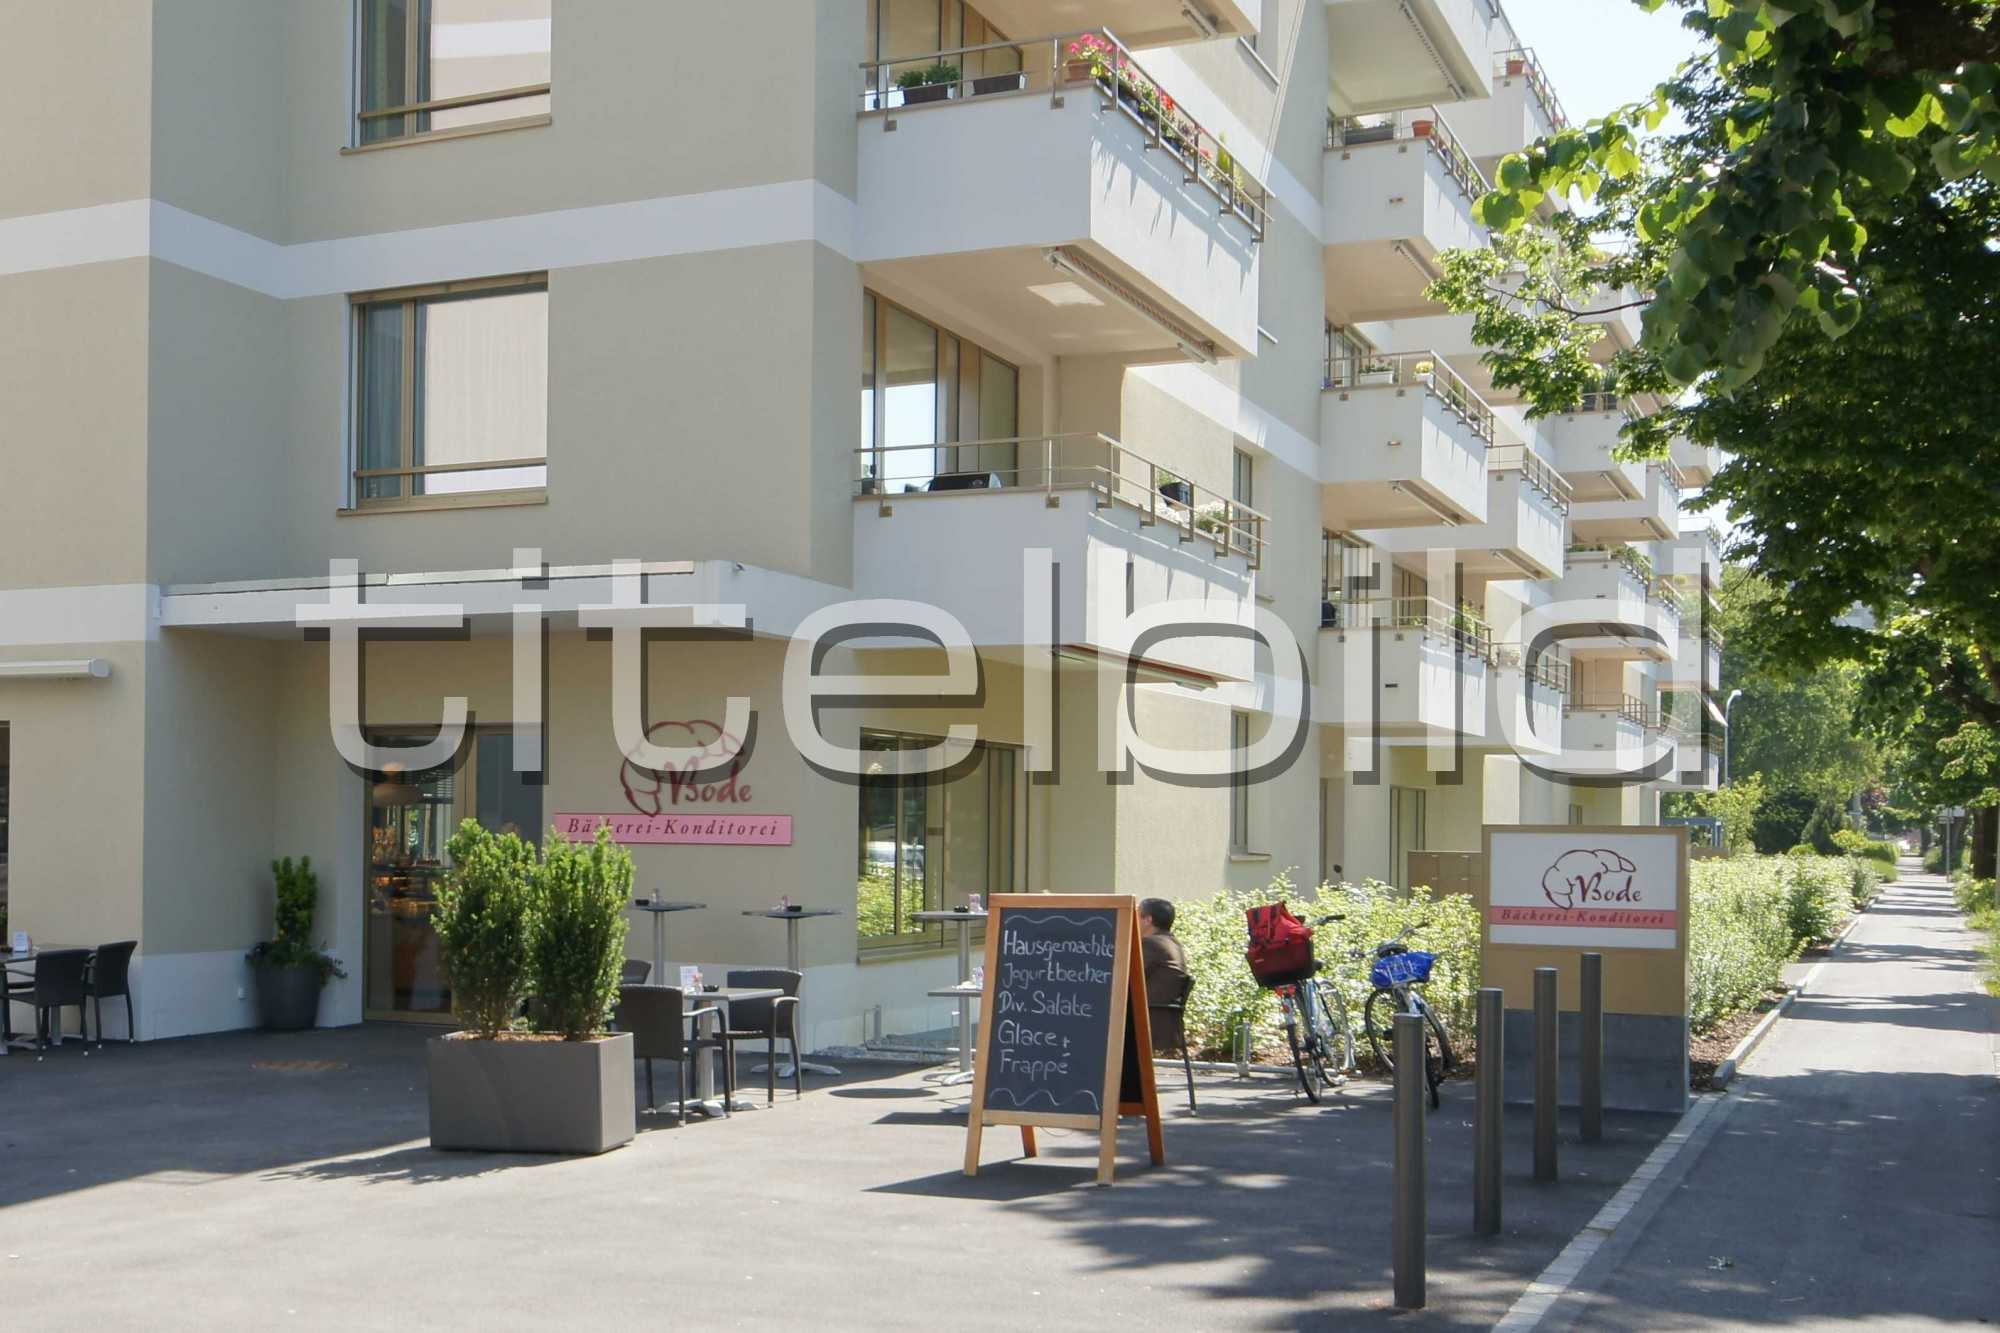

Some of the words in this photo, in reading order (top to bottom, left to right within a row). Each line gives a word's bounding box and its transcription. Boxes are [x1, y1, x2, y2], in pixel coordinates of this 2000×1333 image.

[663, 755, 753, 806] Bode
[1575, 872, 1643, 903] Bode
[1500, 908, 1665, 925] Bäckerei-Konditorei
[1003, 929, 1115, 960] Hausgemachte
[1002, 961, 1112, 989] Jogurtbecher
[998, 990, 1027, 1014] Div.
[1032, 990, 1093, 1017] Salate
[998, 1019, 1058, 1046] Glace
[1000, 1049, 1071, 1082] Frappé
